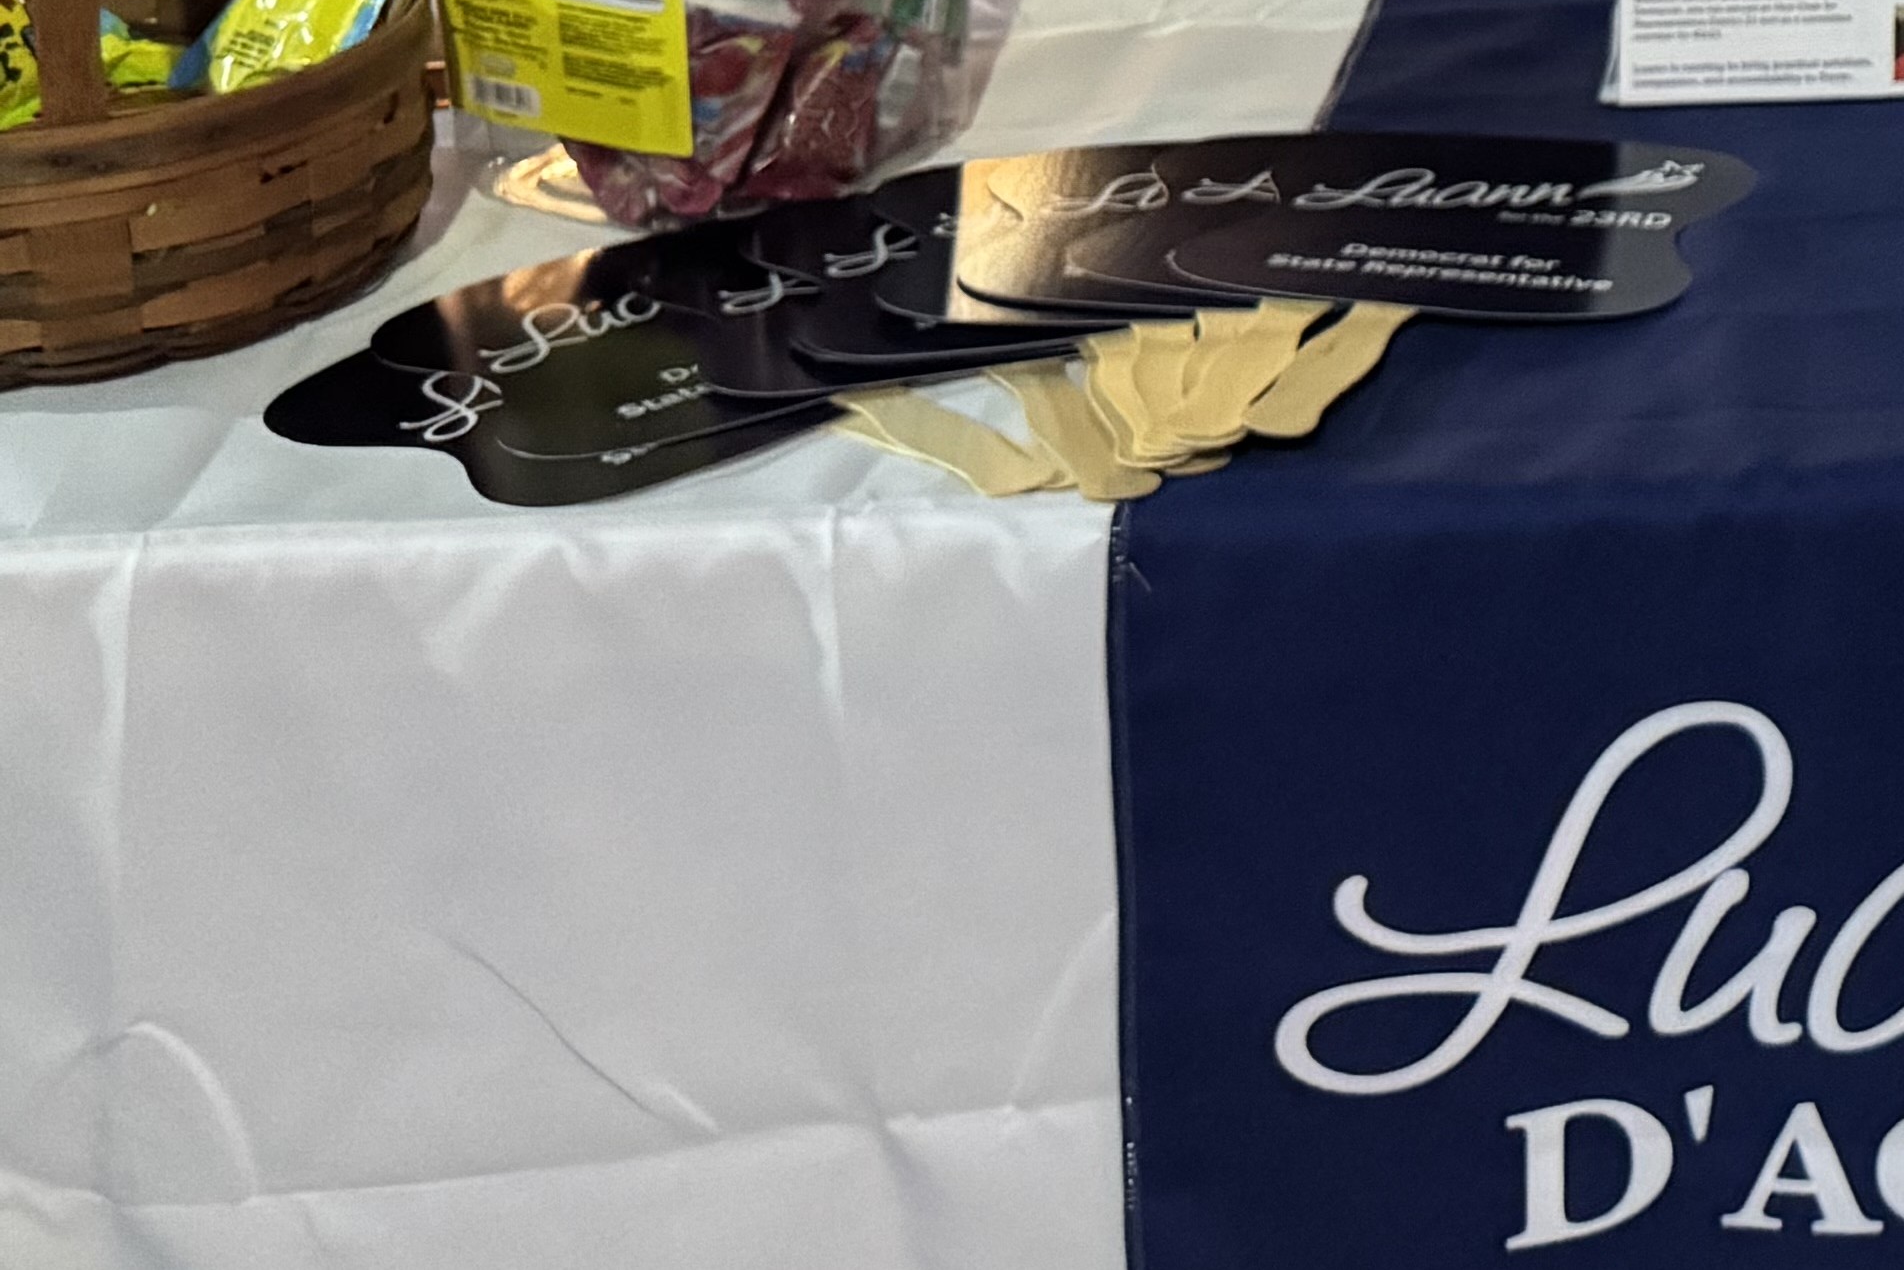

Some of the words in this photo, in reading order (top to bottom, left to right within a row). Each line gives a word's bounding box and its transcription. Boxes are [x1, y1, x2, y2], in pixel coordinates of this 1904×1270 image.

[1293, 167, 1574, 211] Luann
[1267, 251, 1358, 274] State
[1361, 259, 1615, 292] Representative
[1340, 242, 1505, 270] Democrat
[1509, 253, 1562, 272] for
